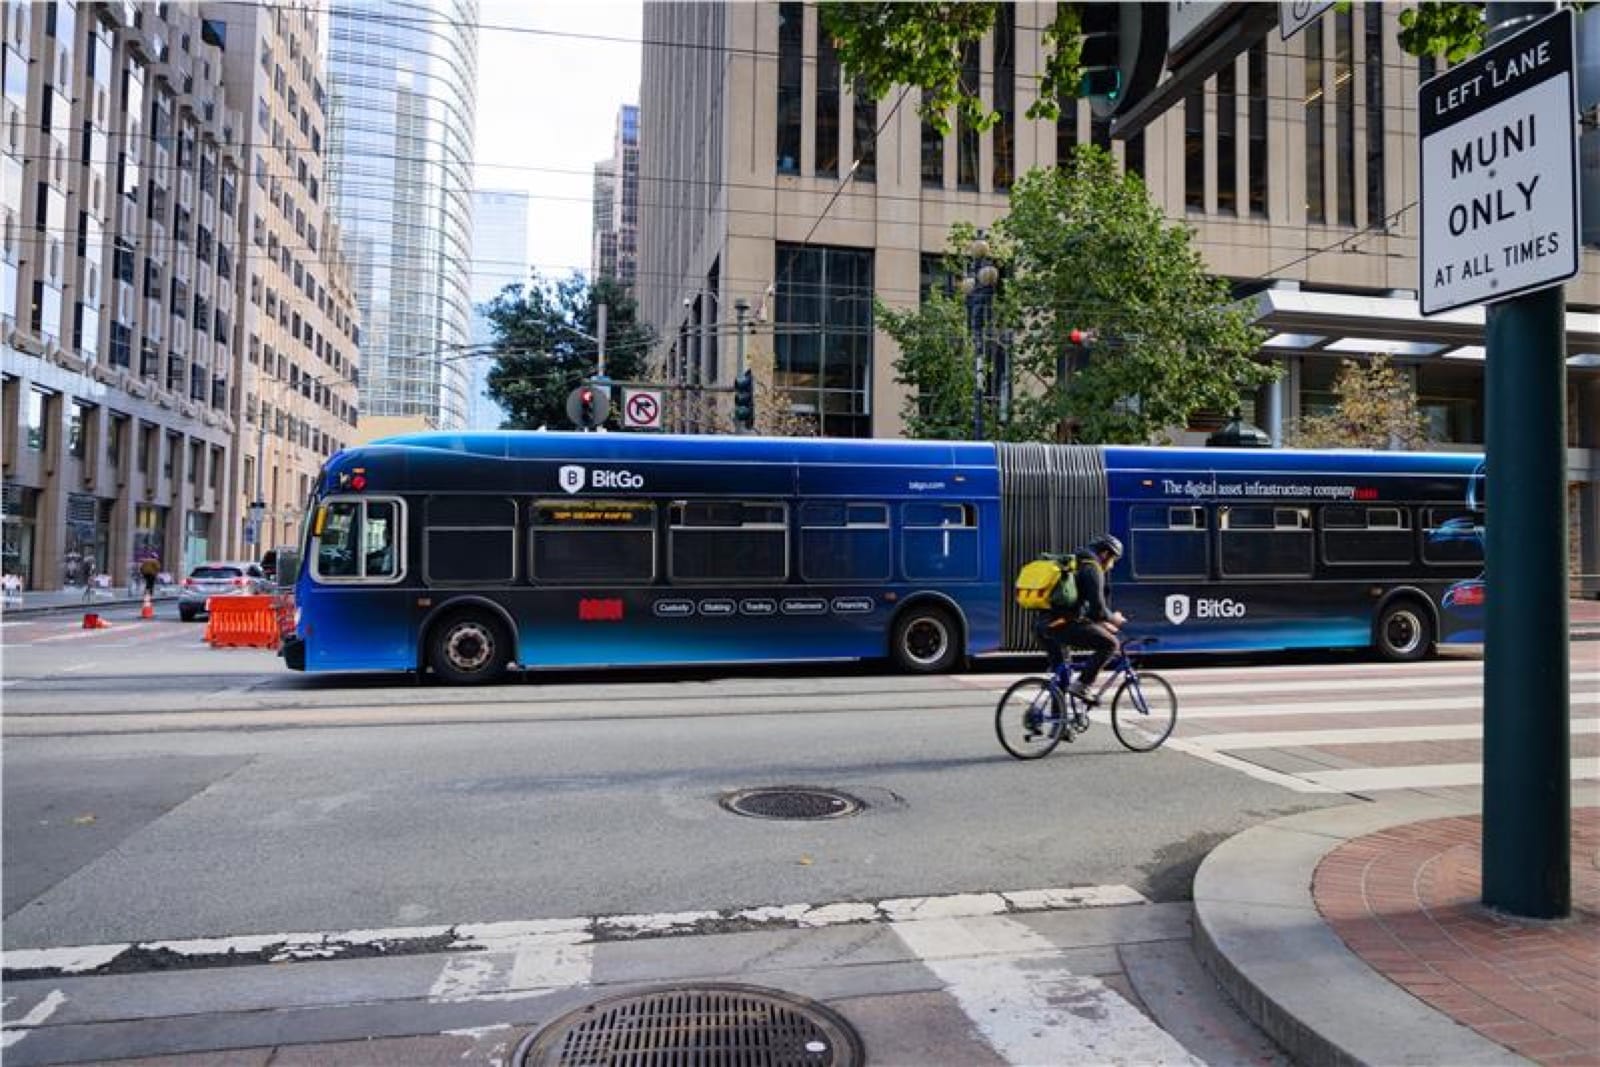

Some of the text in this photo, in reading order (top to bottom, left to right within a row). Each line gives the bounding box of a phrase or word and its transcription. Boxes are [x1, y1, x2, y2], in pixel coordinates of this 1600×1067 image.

[1434, 41, 1551, 115] LEFT LANE
[1451, 113, 1536, 179] MUNI
[1448, 173, 1540, 236] ONLY
[1434, 232, 1560, 288] AT ALL TIMES
[592, 469, 644, 488] BitGo
[1161, 479, 1183, 494] The
[1184, 479, 1216, 499] digital
[1218, 483, 1242, 496] asset
[1244, 480, 1312, 496] infrastructure
[1313, 485, 1356, 499] company
[1196, 598, 1246, 617] BitGo
